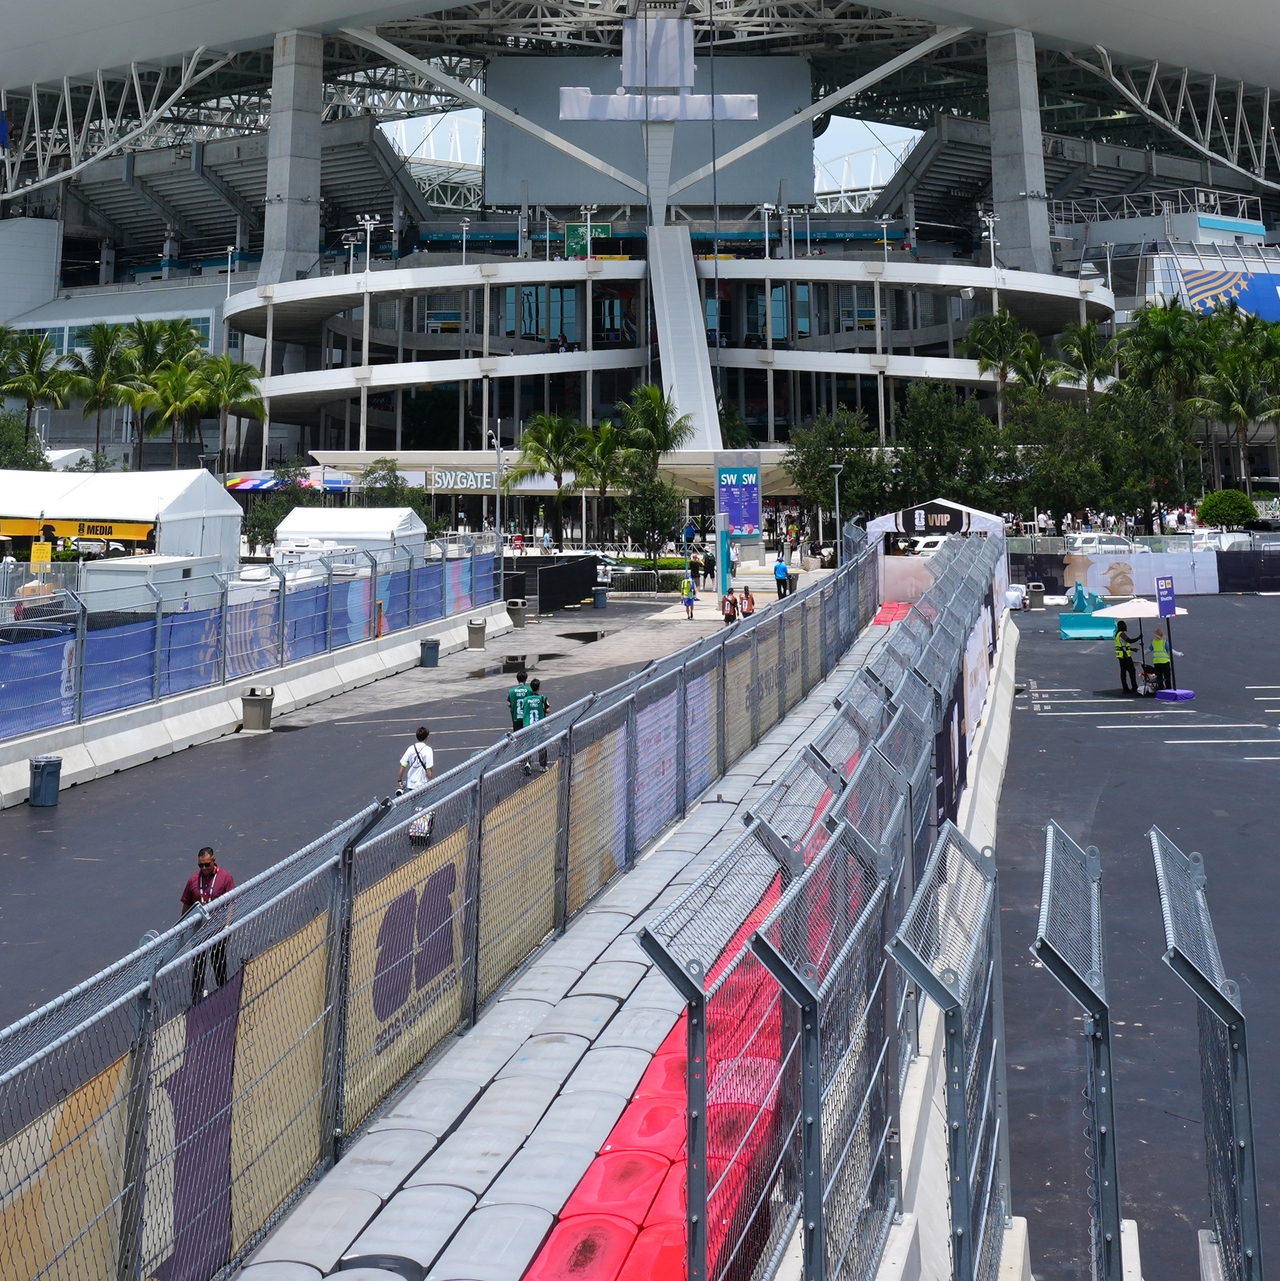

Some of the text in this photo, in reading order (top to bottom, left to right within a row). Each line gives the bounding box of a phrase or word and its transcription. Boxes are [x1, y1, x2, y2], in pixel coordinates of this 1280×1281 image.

[435, 472, 492, 488] SW GATE
[721, 473, 737, 485] SW
[742, 473, 756, 485] SW
[927, 514, 950, 526] VVIP
[87, 525, 113, 536] MEDIA
